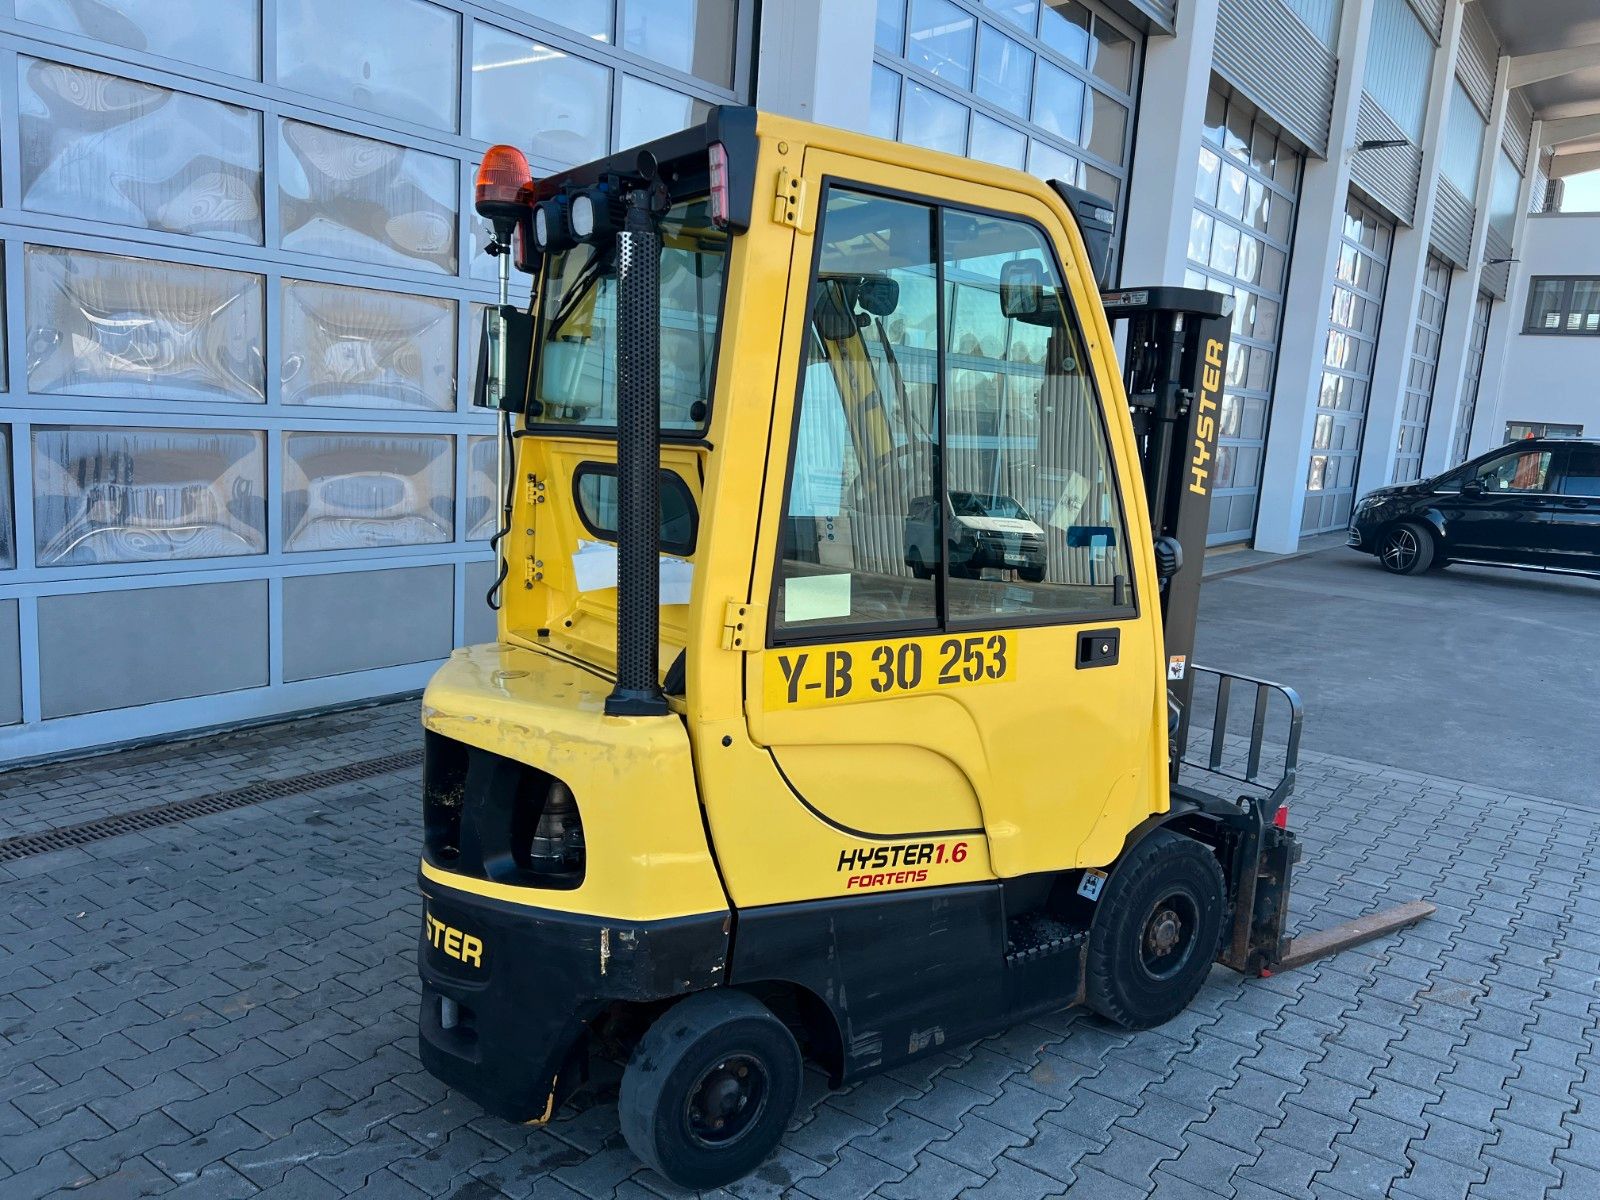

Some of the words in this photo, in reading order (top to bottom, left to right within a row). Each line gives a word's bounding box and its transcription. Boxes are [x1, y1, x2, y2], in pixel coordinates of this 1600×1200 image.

[1189, 338, 1224, 496] HYSTER
[778, 650, 853, 704] Y-B
[870, 643, 922, 693] 30
[938, 635, 1007, 685] 253
[837, 843, 934, 872] HYSTER
[935, 842, 968, 864] 1.6
[847, 869, 928, 889] FORTENS
